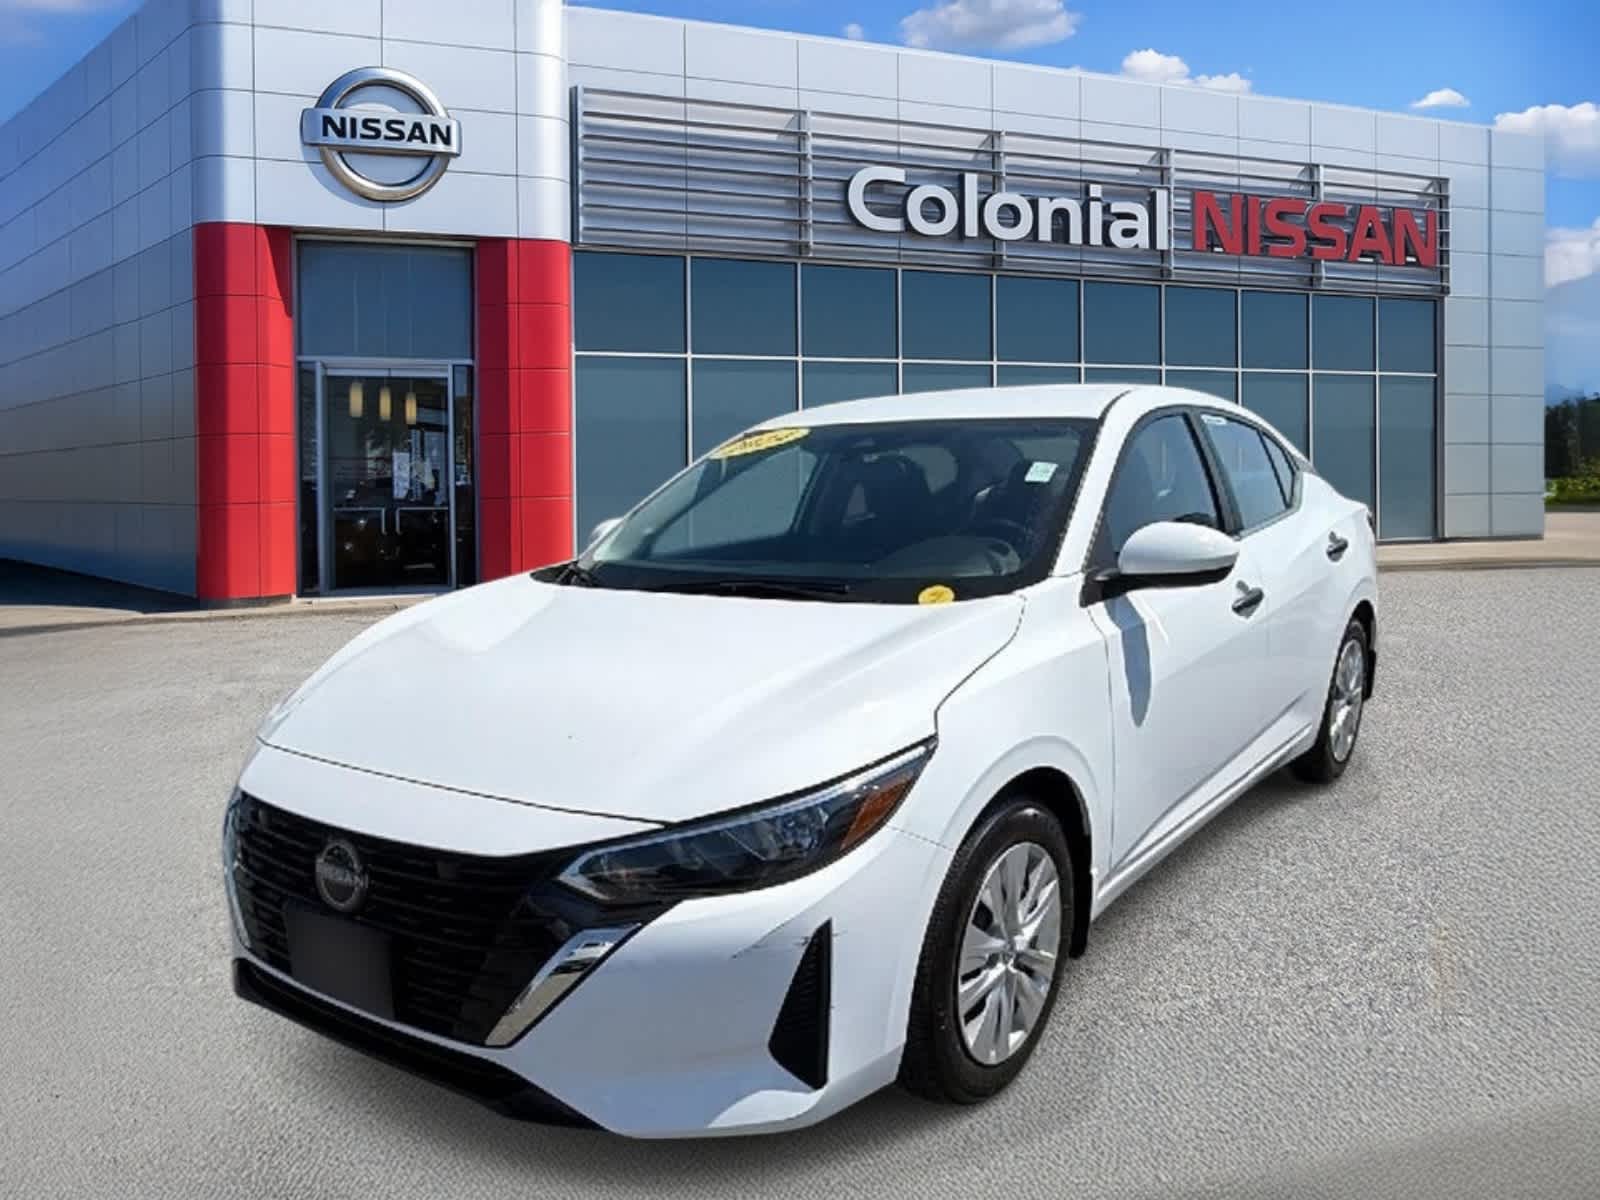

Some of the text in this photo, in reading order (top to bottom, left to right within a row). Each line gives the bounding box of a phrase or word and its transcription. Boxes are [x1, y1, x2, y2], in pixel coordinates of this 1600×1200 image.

[321, 115, 452, 146] NISSAN
[847, 166, 1437, 267] Colonial NISSAN
